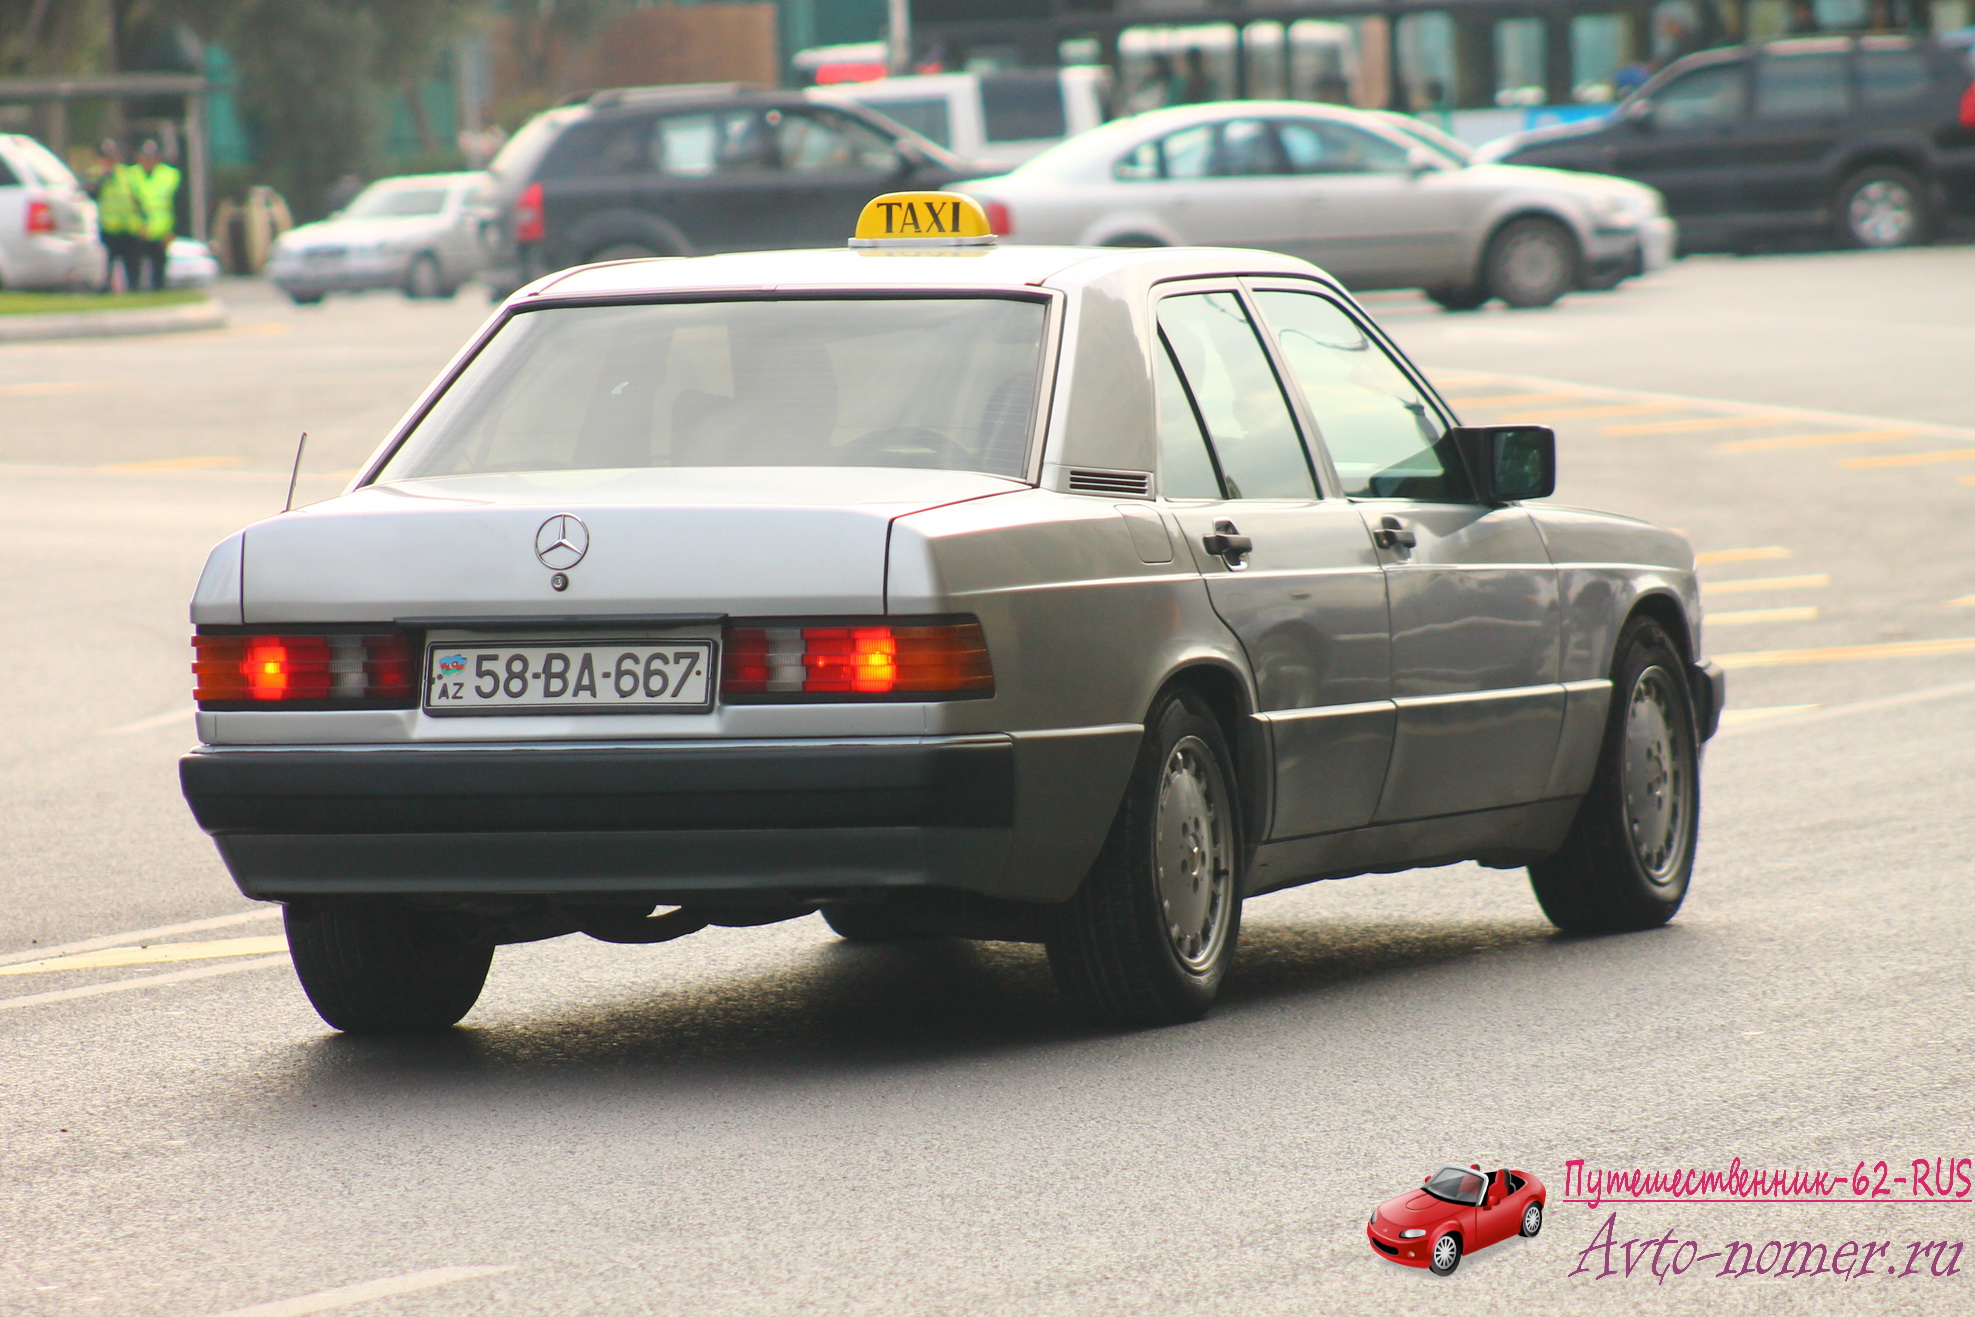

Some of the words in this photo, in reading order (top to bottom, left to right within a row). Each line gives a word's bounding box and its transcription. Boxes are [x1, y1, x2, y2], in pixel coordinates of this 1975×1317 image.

[876, 201, 961, 234] TAXI
[438, 682, 464, 700] AZ
[474, 652, 700, 699] 58-BA-667
